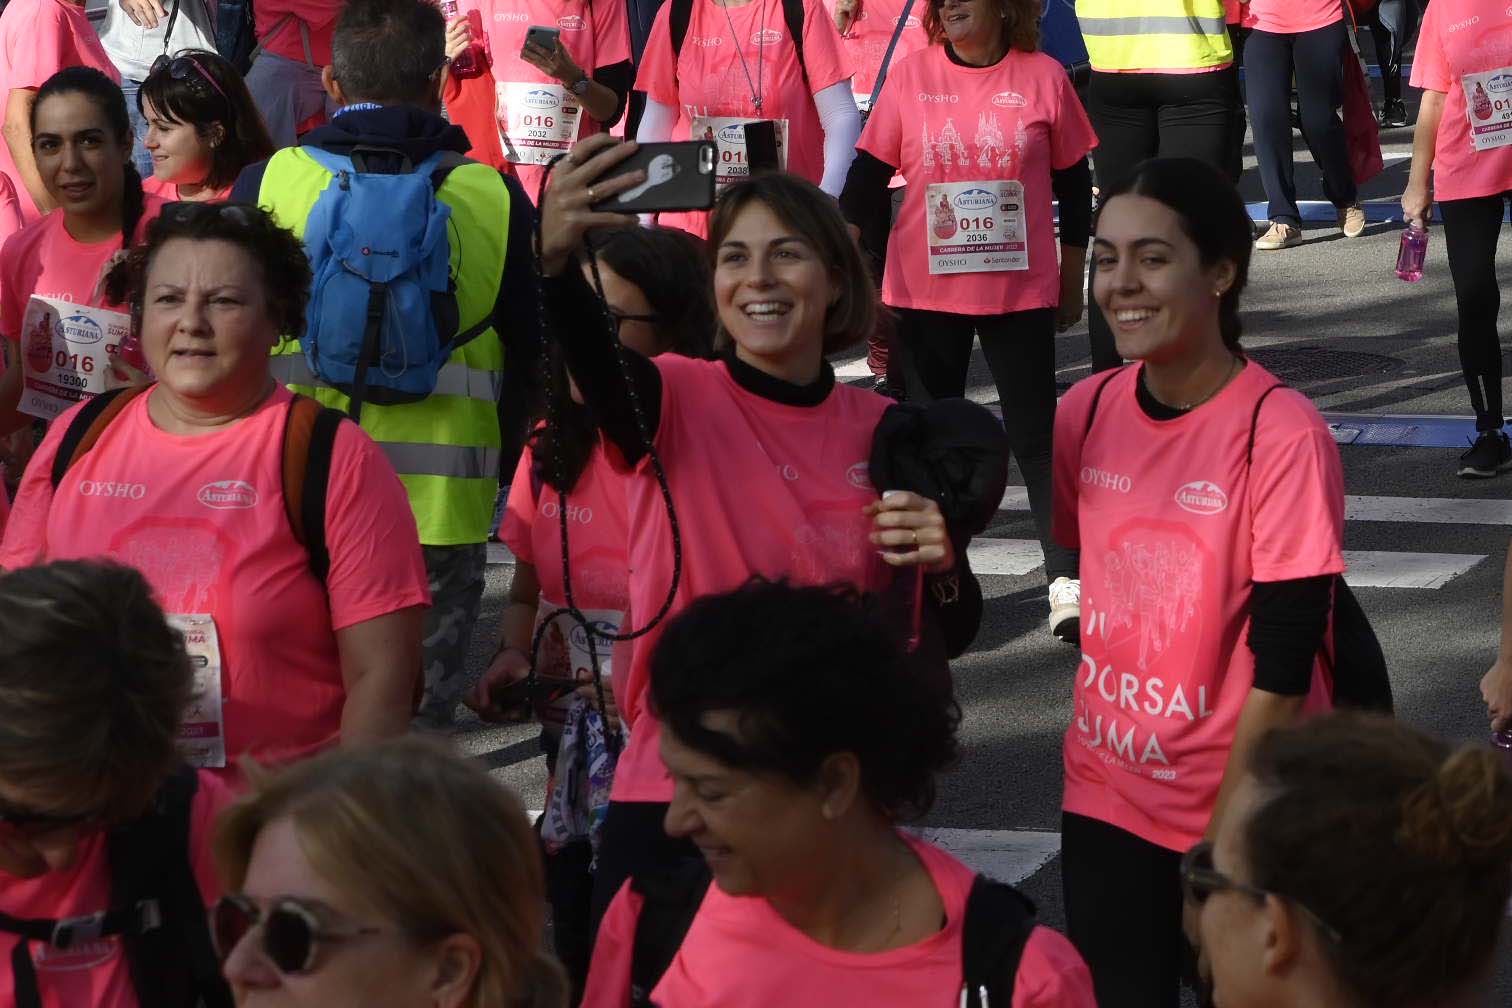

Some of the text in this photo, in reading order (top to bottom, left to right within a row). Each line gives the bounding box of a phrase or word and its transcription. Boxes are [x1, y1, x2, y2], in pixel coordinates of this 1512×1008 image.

[918, 92, 959, 104] OYSHO
[523, 115, 554, 128] 016
[528, 130, 547, 138] 2032
[723, 150, 748, 163] 01
[727, 166, 748, 175] 2038
[957, 195, 995, 205] ASTURIANA
[960, 217, 994, 230] 016
[966, 234, 988, 242] 2036
[938, 257, 1021, 268] OYSHO Santander
[55, 350, 94, 372] 016
[58, 374, 88, 388] 19300
[1080, 466, 1132, 493] OYSHO
[80, 480, 146, 500] OYSHO
